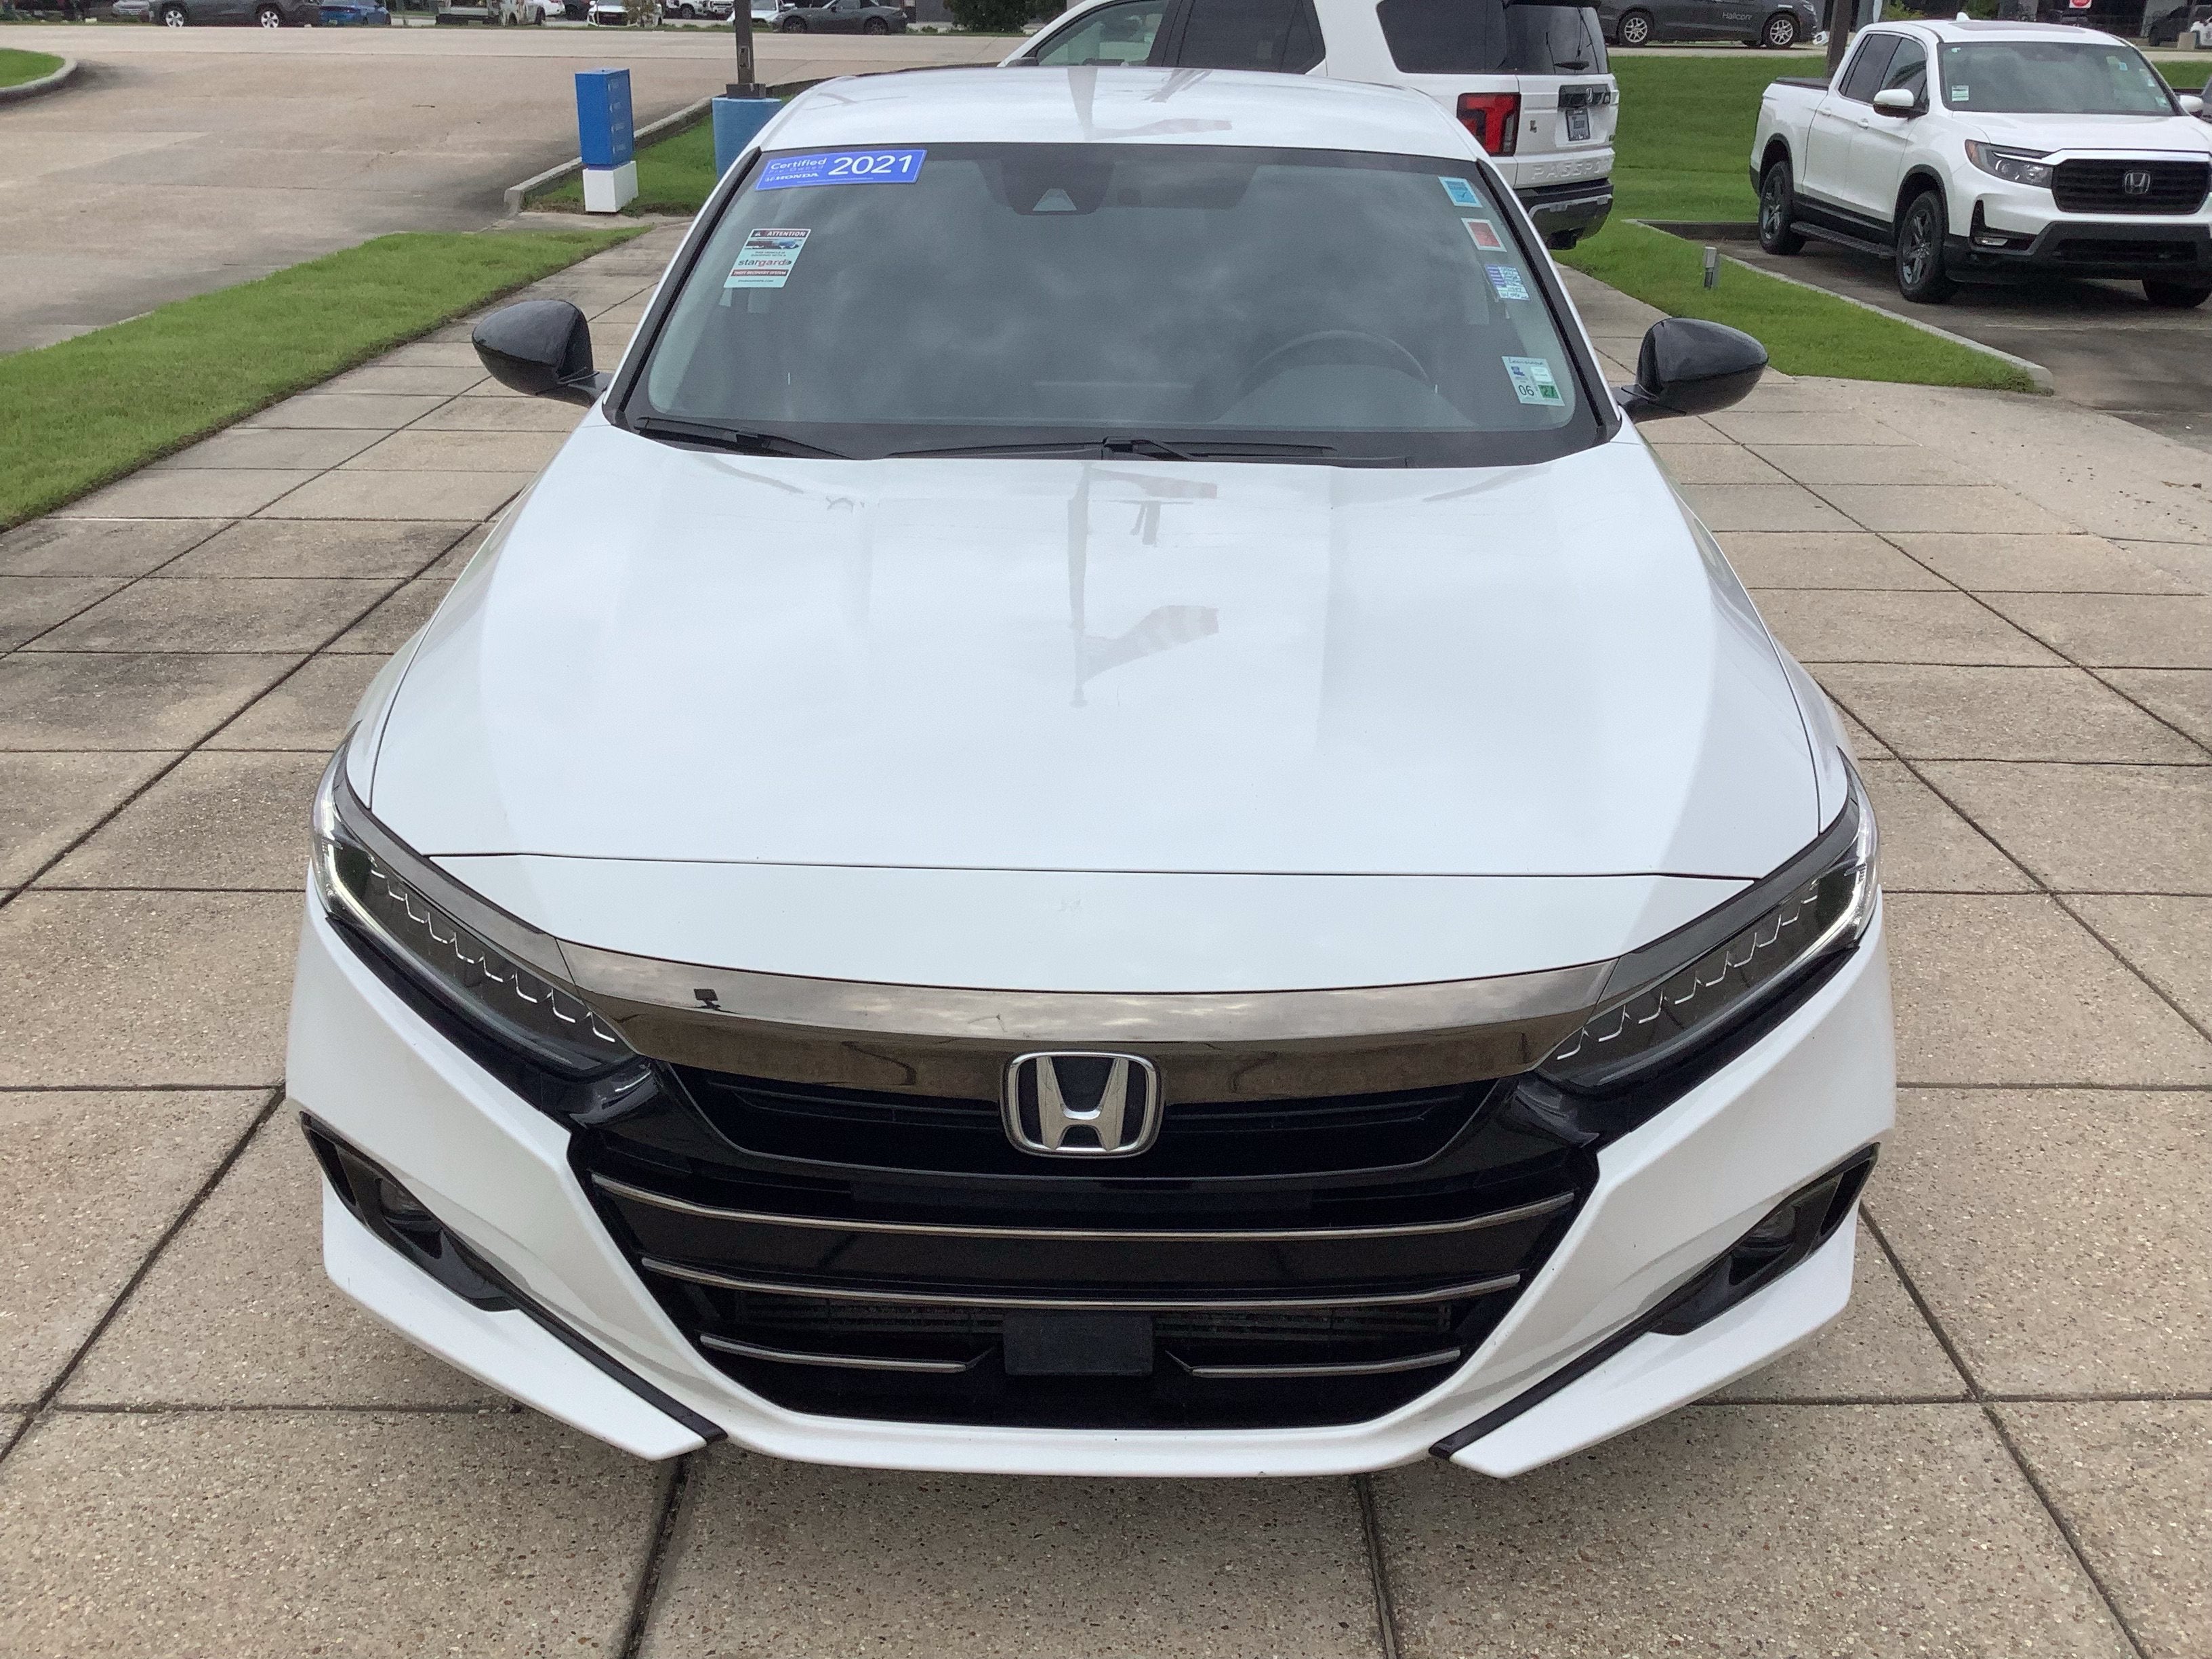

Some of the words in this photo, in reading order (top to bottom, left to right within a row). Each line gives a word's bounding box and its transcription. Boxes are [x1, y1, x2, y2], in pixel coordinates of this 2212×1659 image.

[771, 157, 827, 169] Certified
[828, 155, 912, 176] 2021
[775, 173, 819, 181] HONDA
[738, 259, 787, 267] stargard
[1519, 384, 1534, 396] 06
